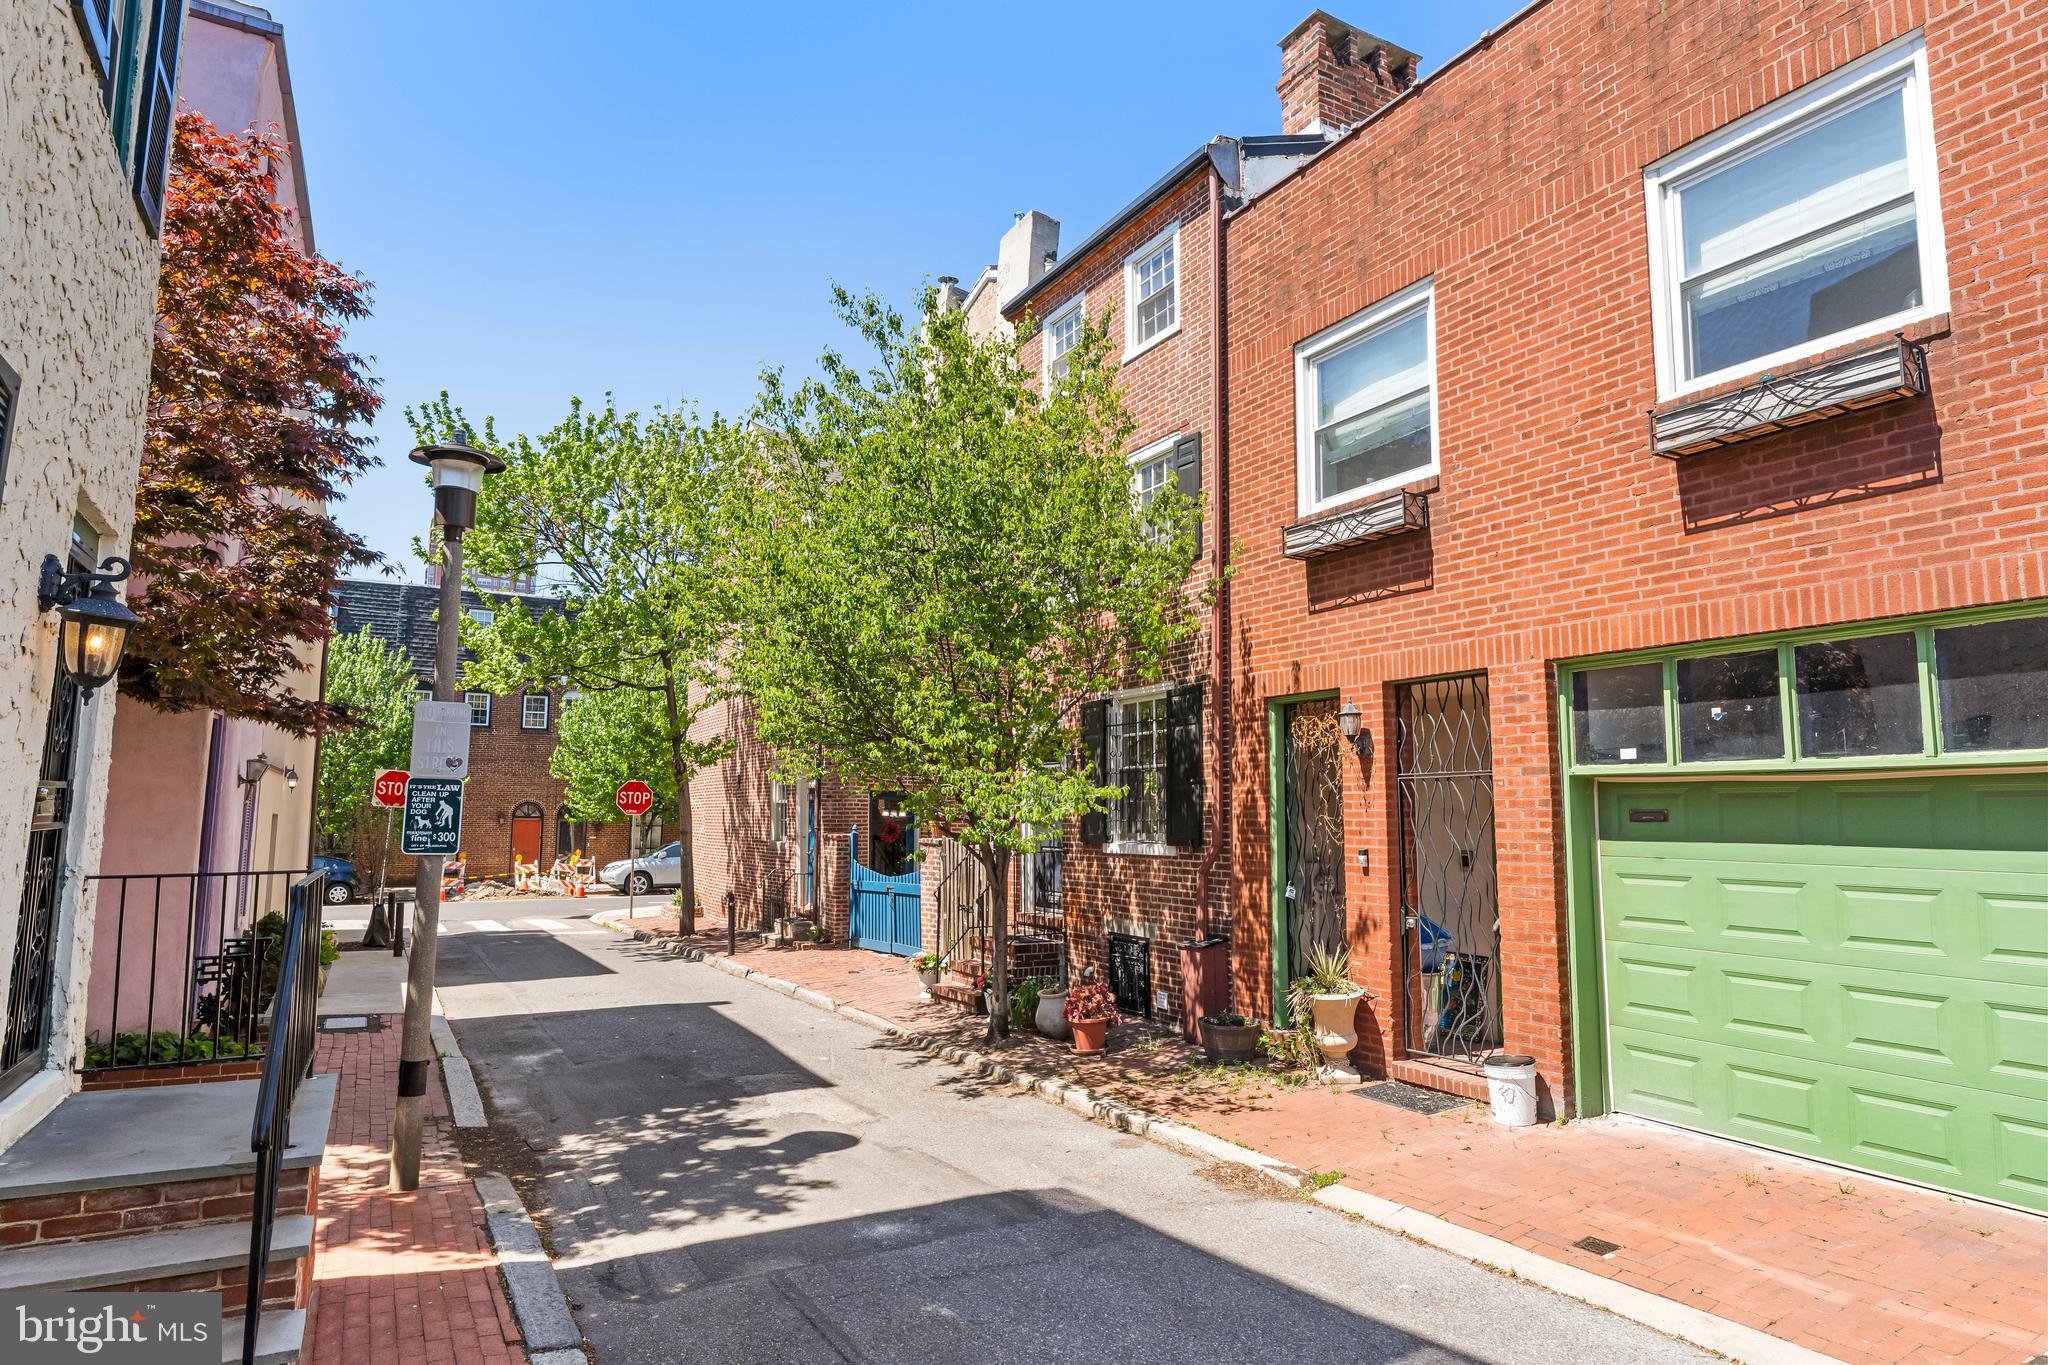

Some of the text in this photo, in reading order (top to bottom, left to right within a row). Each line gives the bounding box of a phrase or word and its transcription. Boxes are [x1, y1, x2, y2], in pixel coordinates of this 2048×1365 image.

[418, 705, 434, 720] NO
[435, 727, 447, 736] IN
[426, 740, 454, 753] THIS
[418, 756, 450, 769] STRE
[377, 780, 403, 796] STO
[619, 791, 650, 805] STOP
